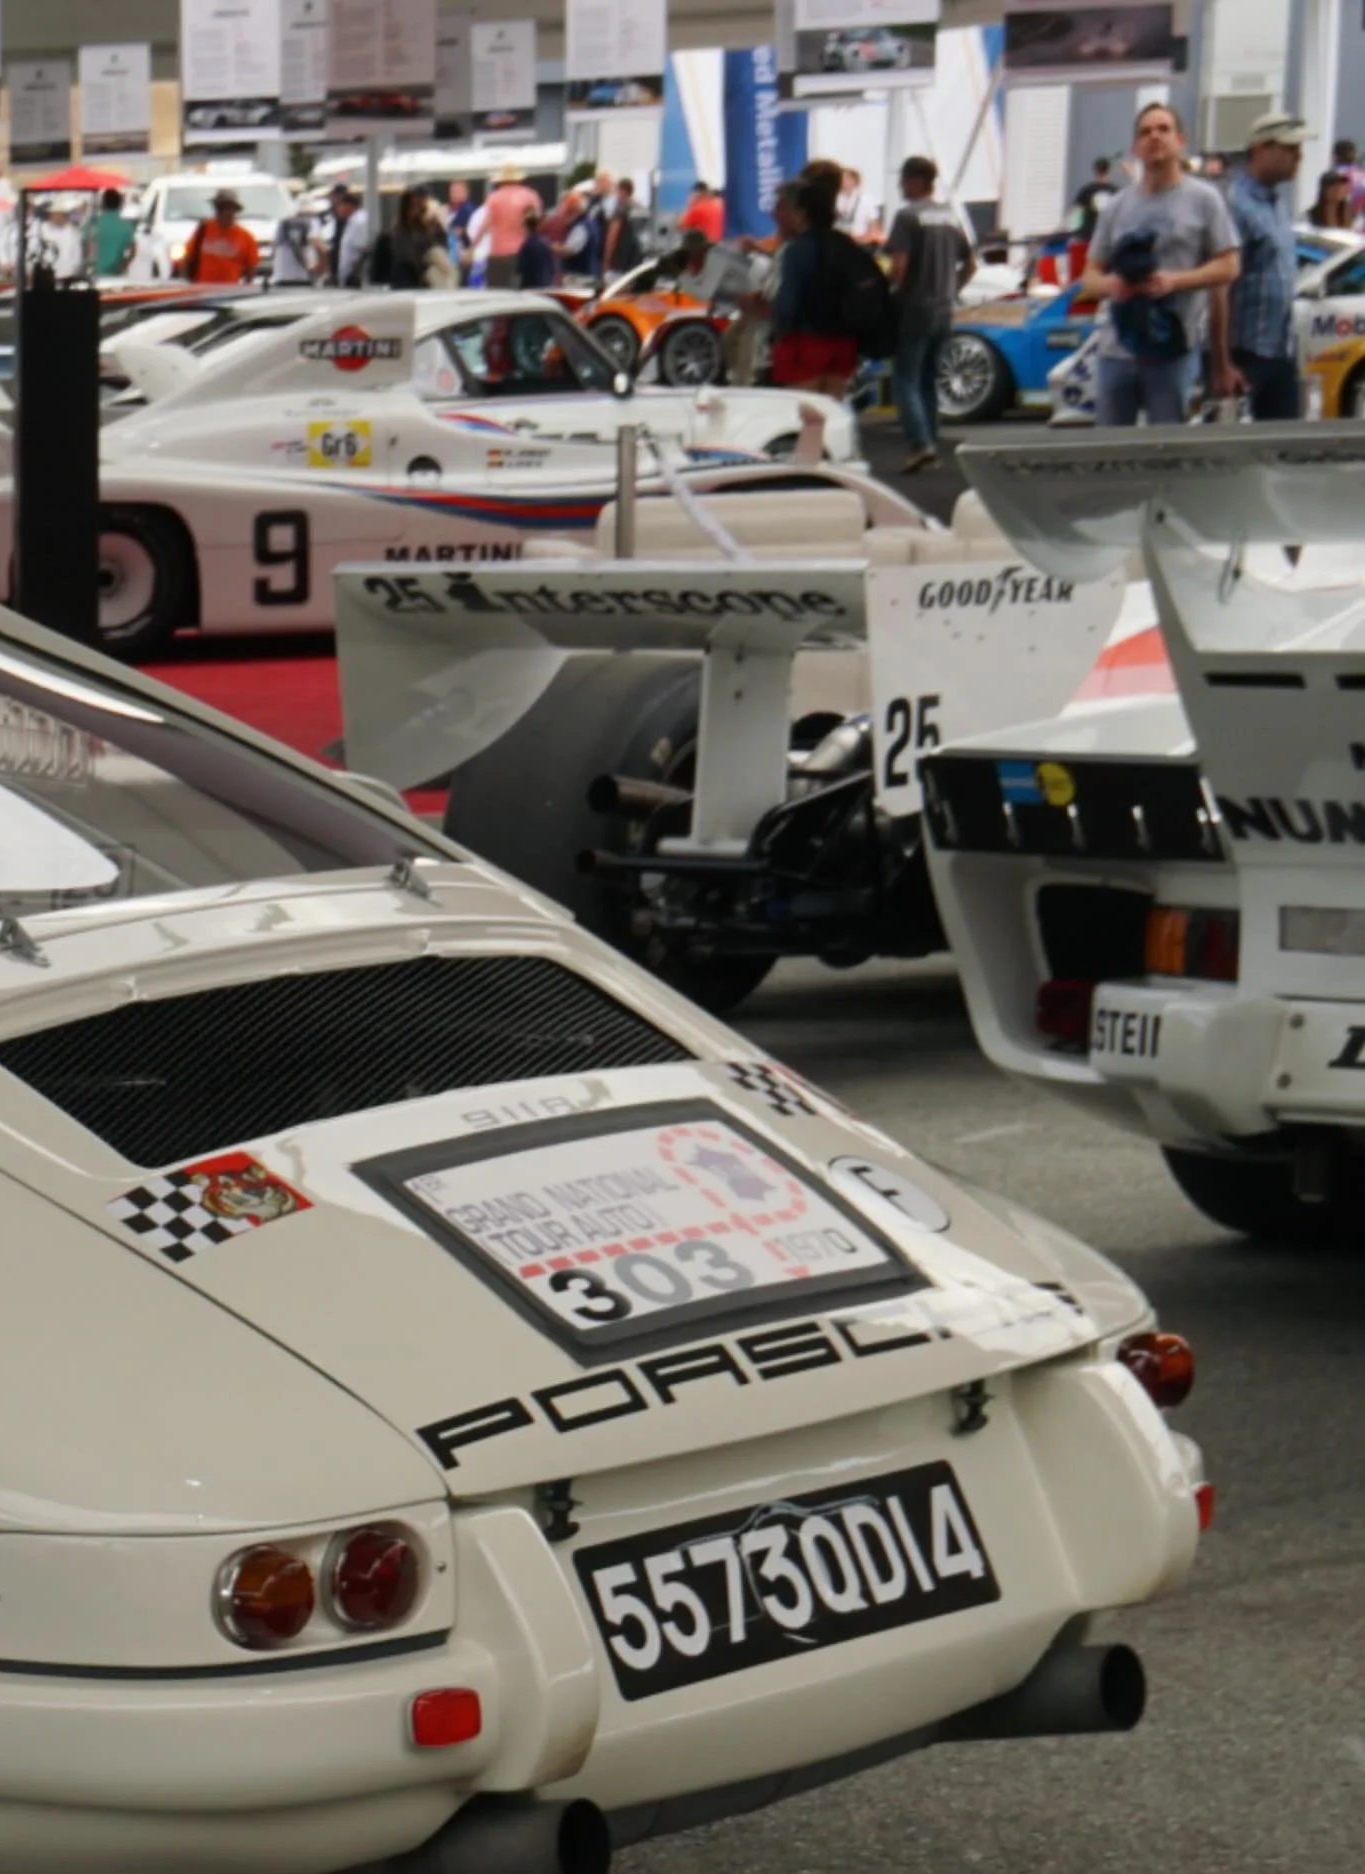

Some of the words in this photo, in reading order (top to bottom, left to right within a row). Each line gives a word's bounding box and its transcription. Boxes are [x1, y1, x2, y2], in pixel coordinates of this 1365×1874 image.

[301, 339, 402, 358] MARTINI
[253, 509, 310, 606] 9
[385, 542, 523, 562] MARTINI
[363, 576, 450, 614] 25
[884, 694, 942, 788] 25
[445, 1191, 552, 1234] GRAND
[541, 1163, 679, 1213] NATIONAL
[548, 1239, 756, 1322] 303
